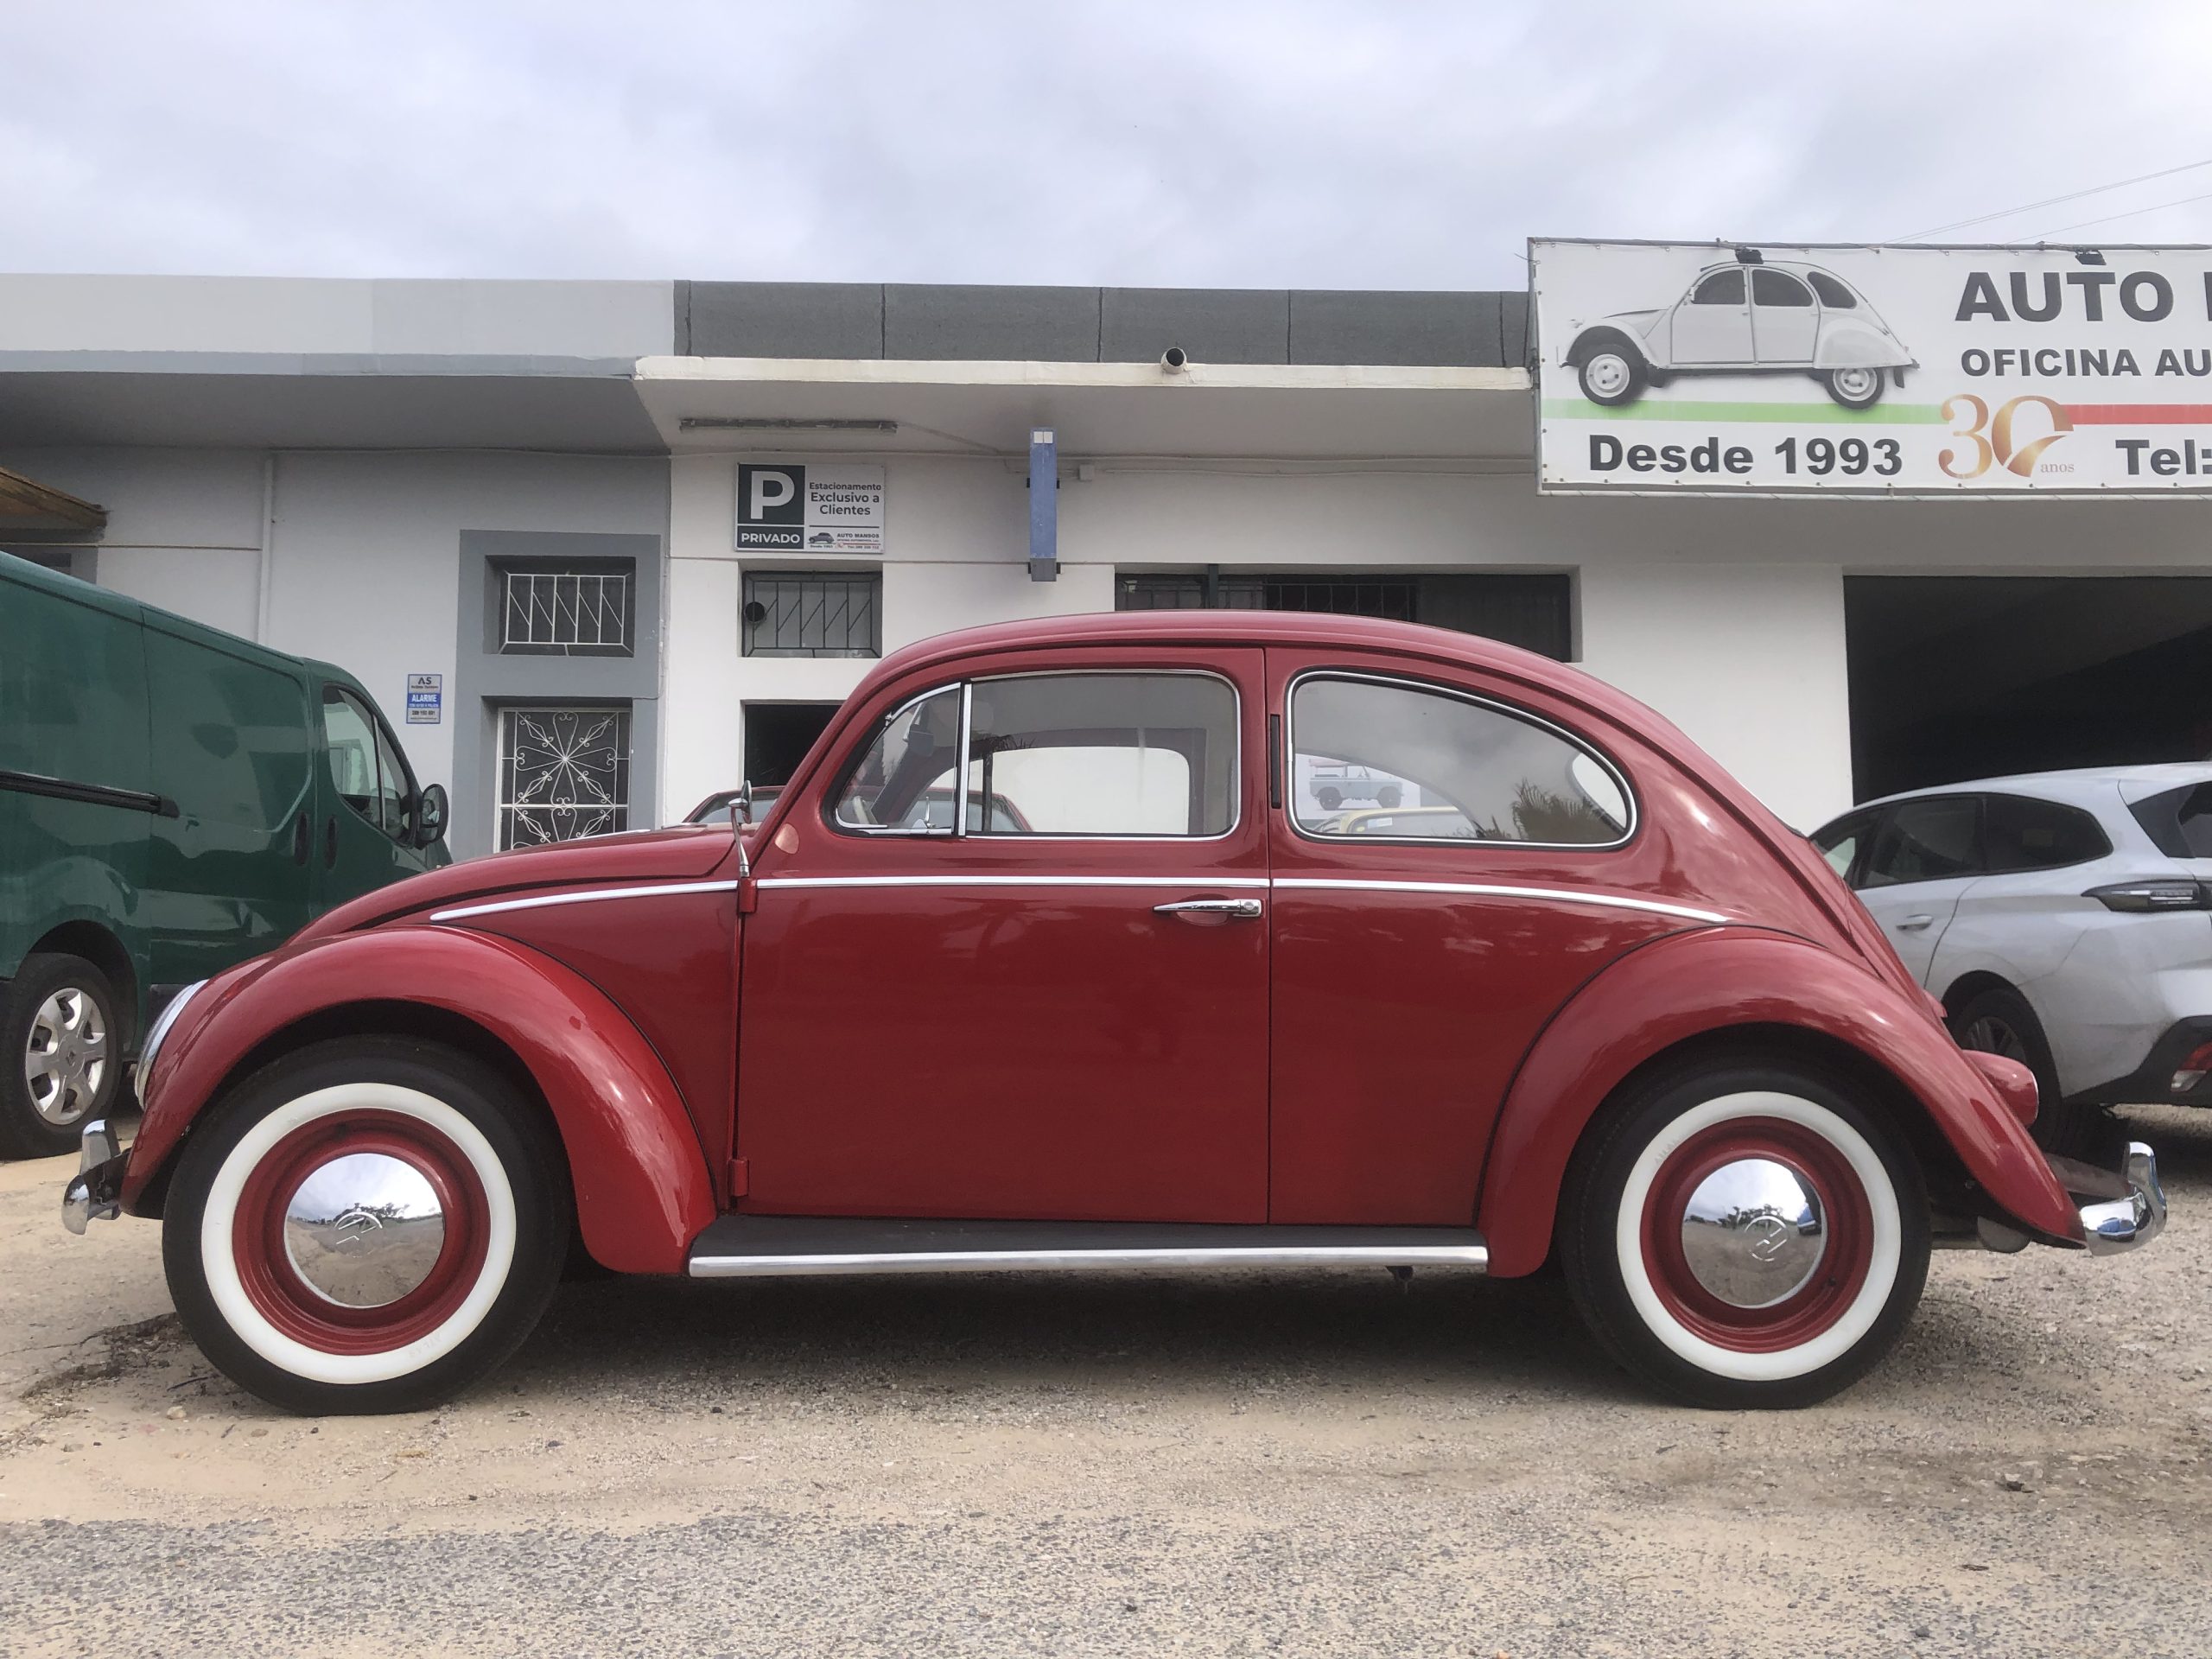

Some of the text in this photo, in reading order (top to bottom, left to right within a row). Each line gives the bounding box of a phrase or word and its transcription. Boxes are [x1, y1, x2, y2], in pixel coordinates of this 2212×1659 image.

[1955, 270, 2174, 322] AUTO
[1961, 348, 2142, 377] OFICINA
[1938, 393, 2075, 480] 30
[1589, 434, 1903, 475] Desde 1993
[2115, 439, 2212, 475] Tel:
[2040, 462, 2075, 474] anos
[750, 470, 795, 520] P
[809, 482, 882, 491] Estacionamento
[810, 492, 880, 503] Exclusivo a
[819, 504, 871, 515] Clientes
[741, 532, 801, 544] PRIVADO
[411, 694, 437, 702] ALARME
